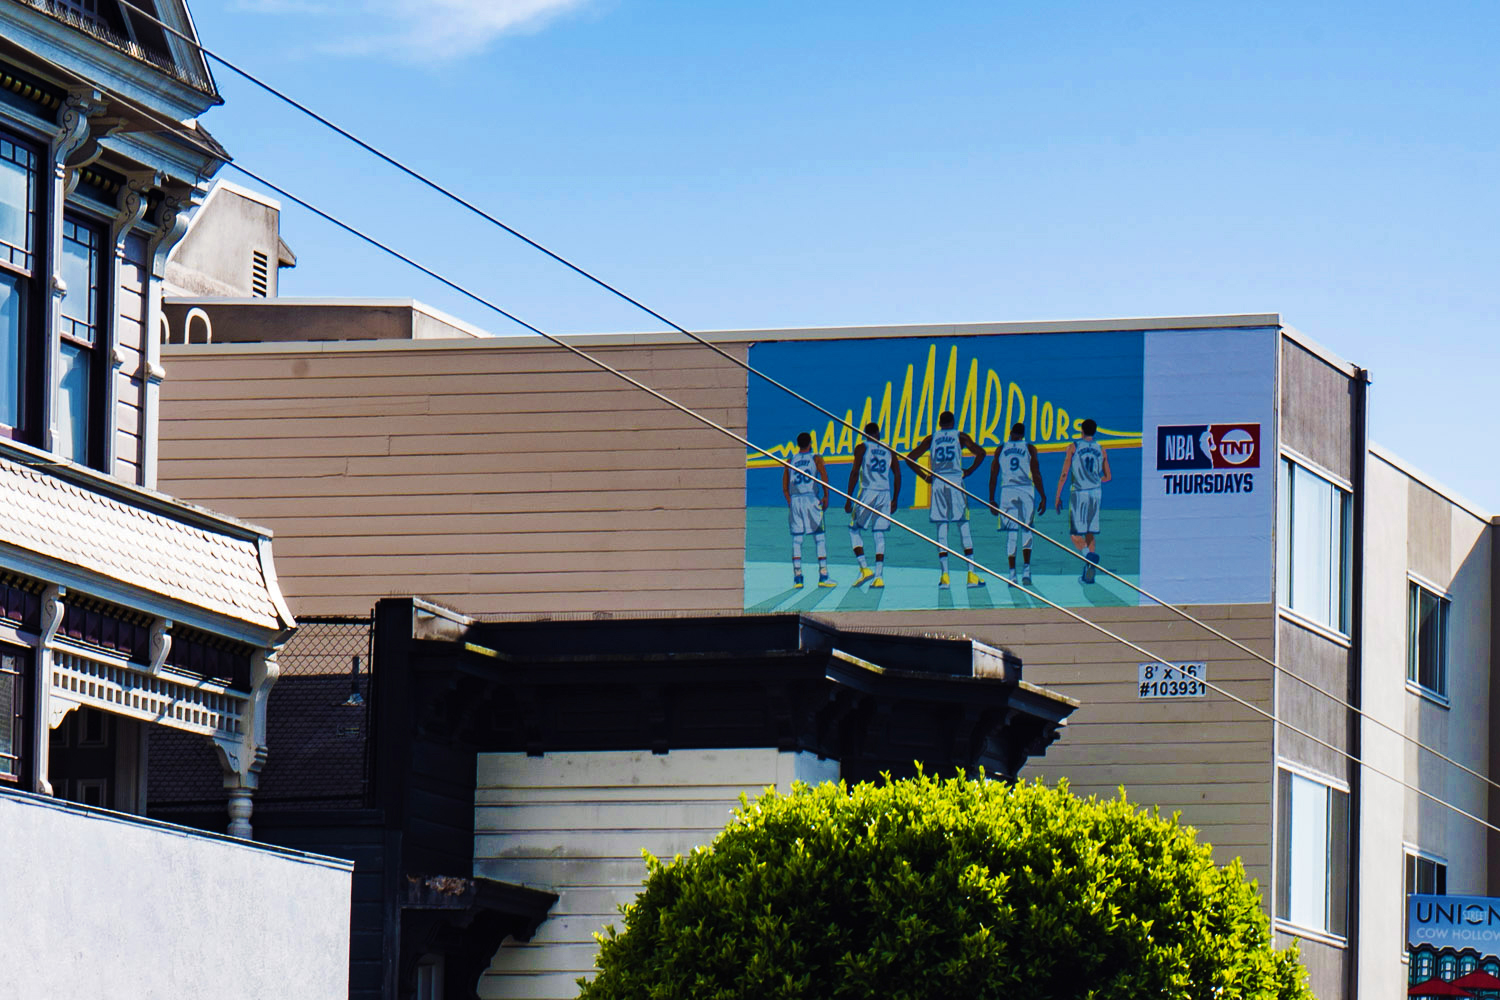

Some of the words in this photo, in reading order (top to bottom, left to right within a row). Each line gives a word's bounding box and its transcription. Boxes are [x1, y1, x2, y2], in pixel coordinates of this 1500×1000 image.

[935, 446, 955, 462] 35
[1165, 434, 1195, 461] NBA
[1220, 440, 1255, 455] TNT
[870, 456, 887, 473] 23
[1009, 456, 1020, 471] 9
[1163, 472, 1254, 495] THURSDAYS
[1163, 669, 1173, 680] x
[1140, 680, 1207, 697] #103931
[1462, 909, 1488, 922] STREET
[1416, 926, 1449, 940] COW
